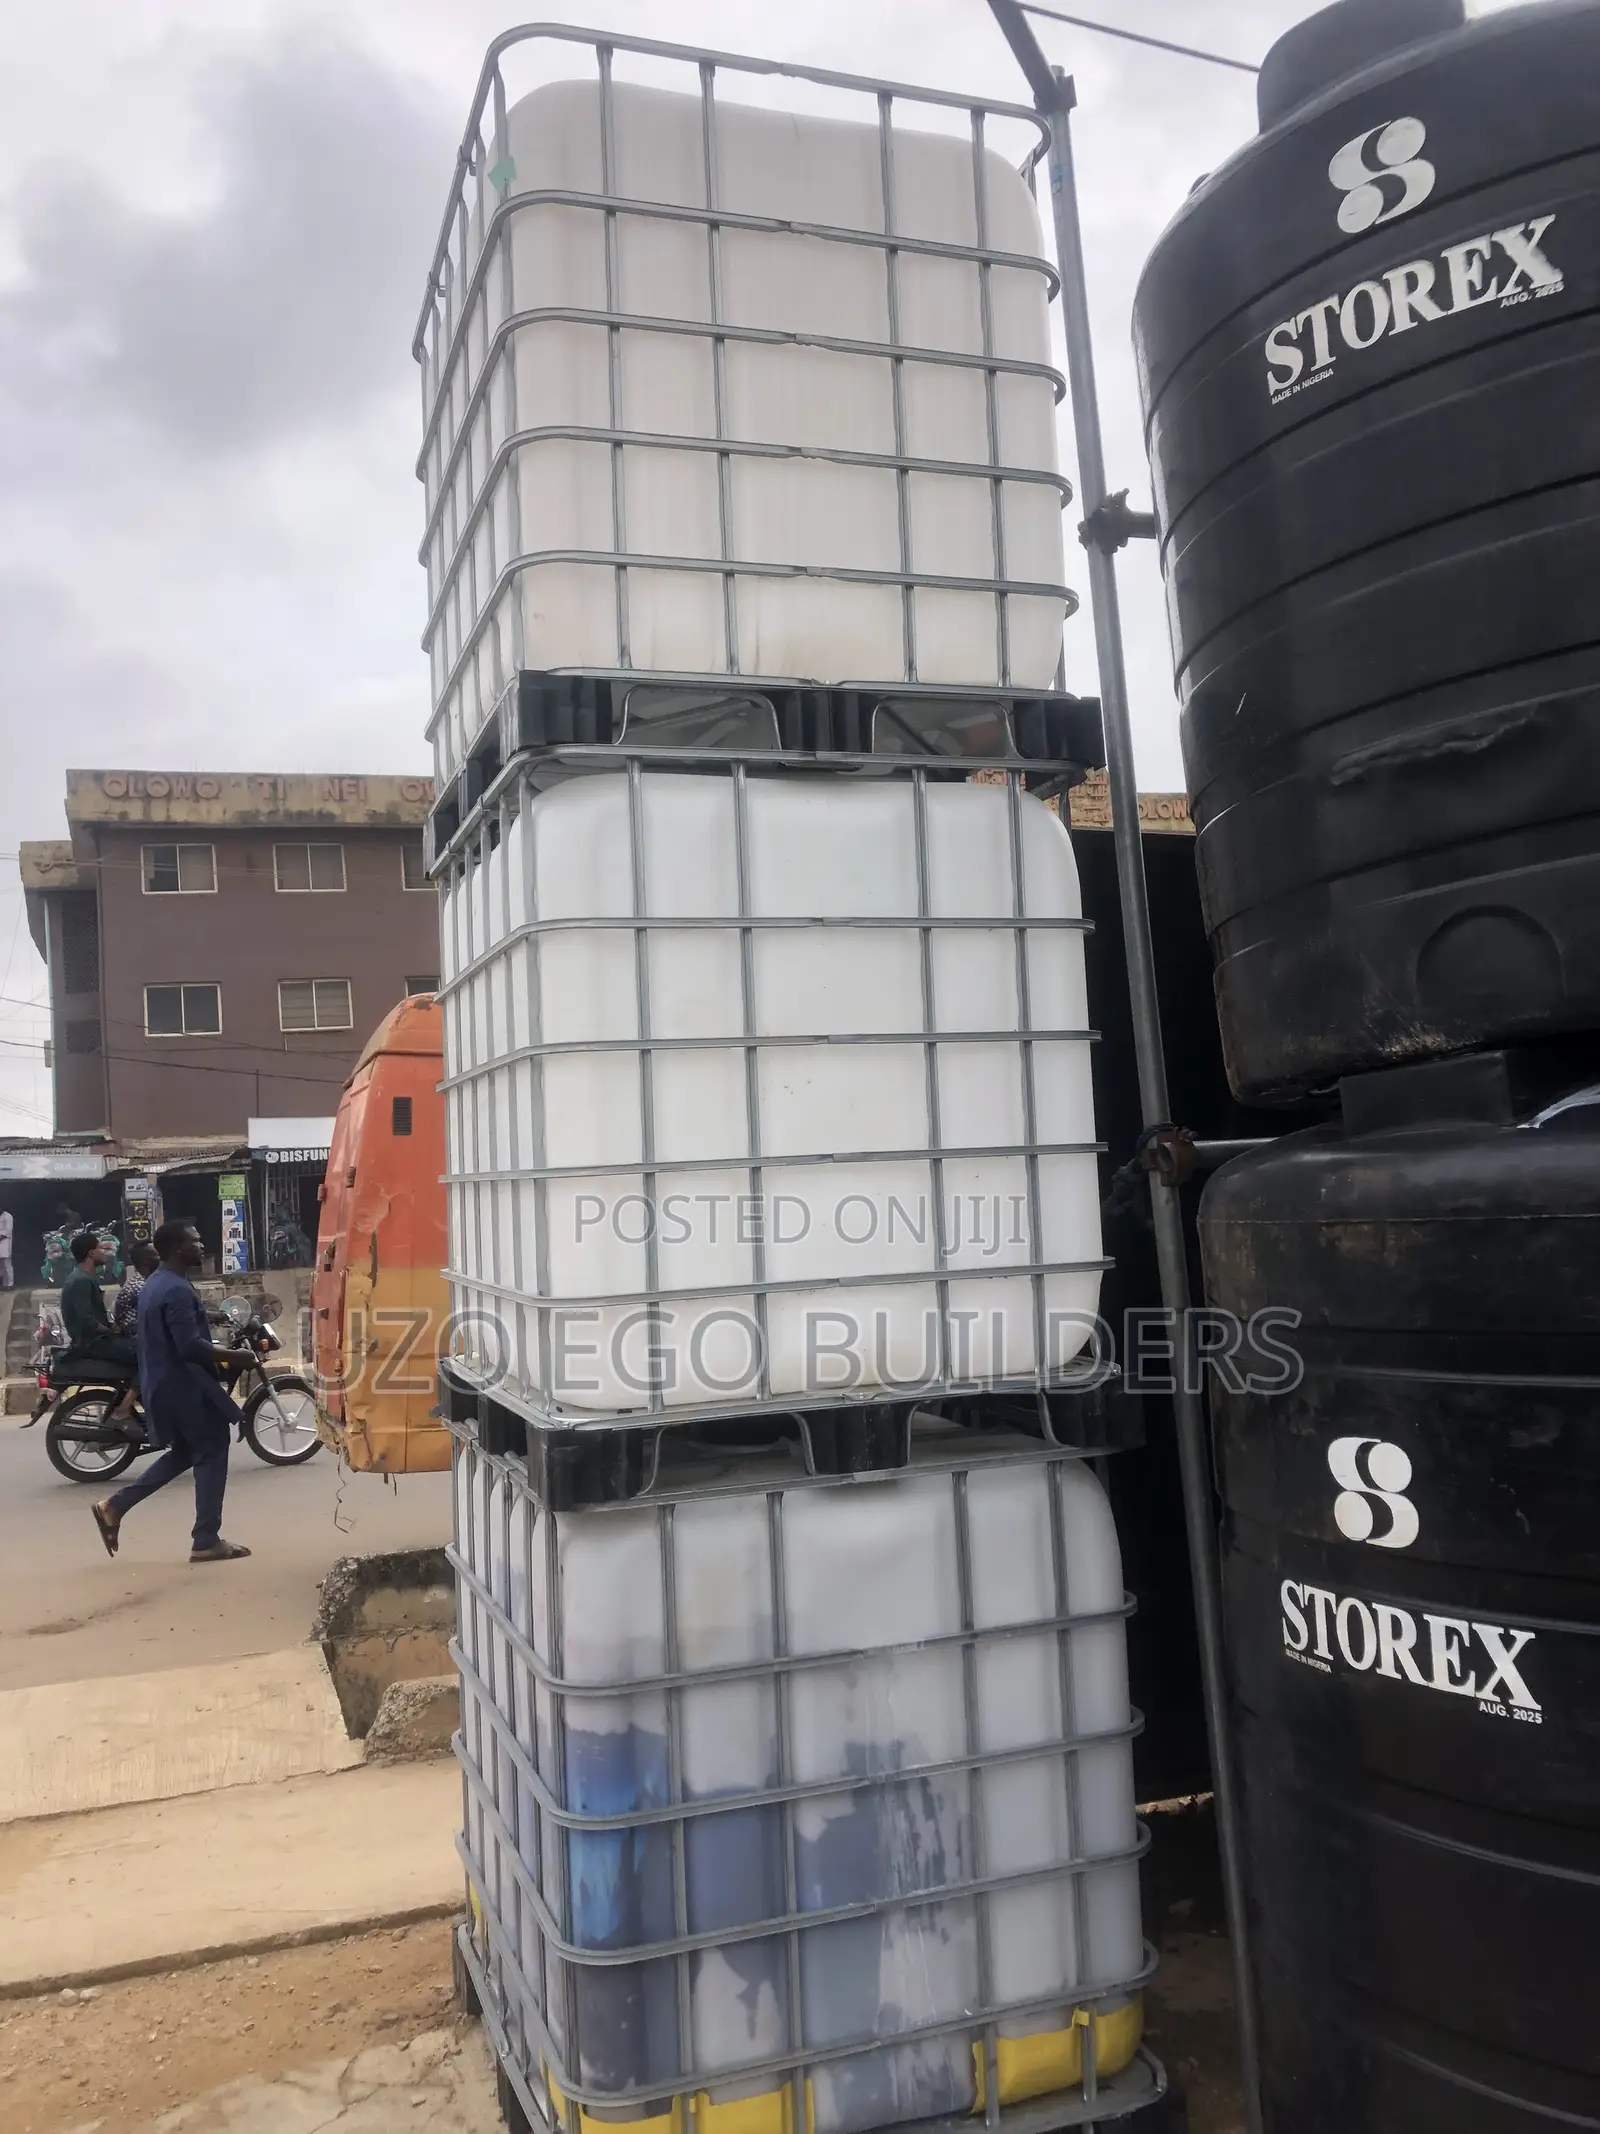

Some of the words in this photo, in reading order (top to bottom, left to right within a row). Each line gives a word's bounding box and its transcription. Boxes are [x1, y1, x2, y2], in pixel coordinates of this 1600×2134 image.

[1264, 212, 1564, 396] STOREX
[1271, 388, 1292, 405] MADE
[1293, 383, 1301, 394] IN
[1302, 367, 1334, 390] NIGERIA
[103, 775, 221, 801] OLOWO
[257, 777, 286, 801] TI
[280, 1148, 332, 1163] BISFUN
[1280, 1579, 1542, 1711] STOREX
[1479, 1701, 1510, 1718] AUG.
[1513, 1708, 1543, 1725] 2025
